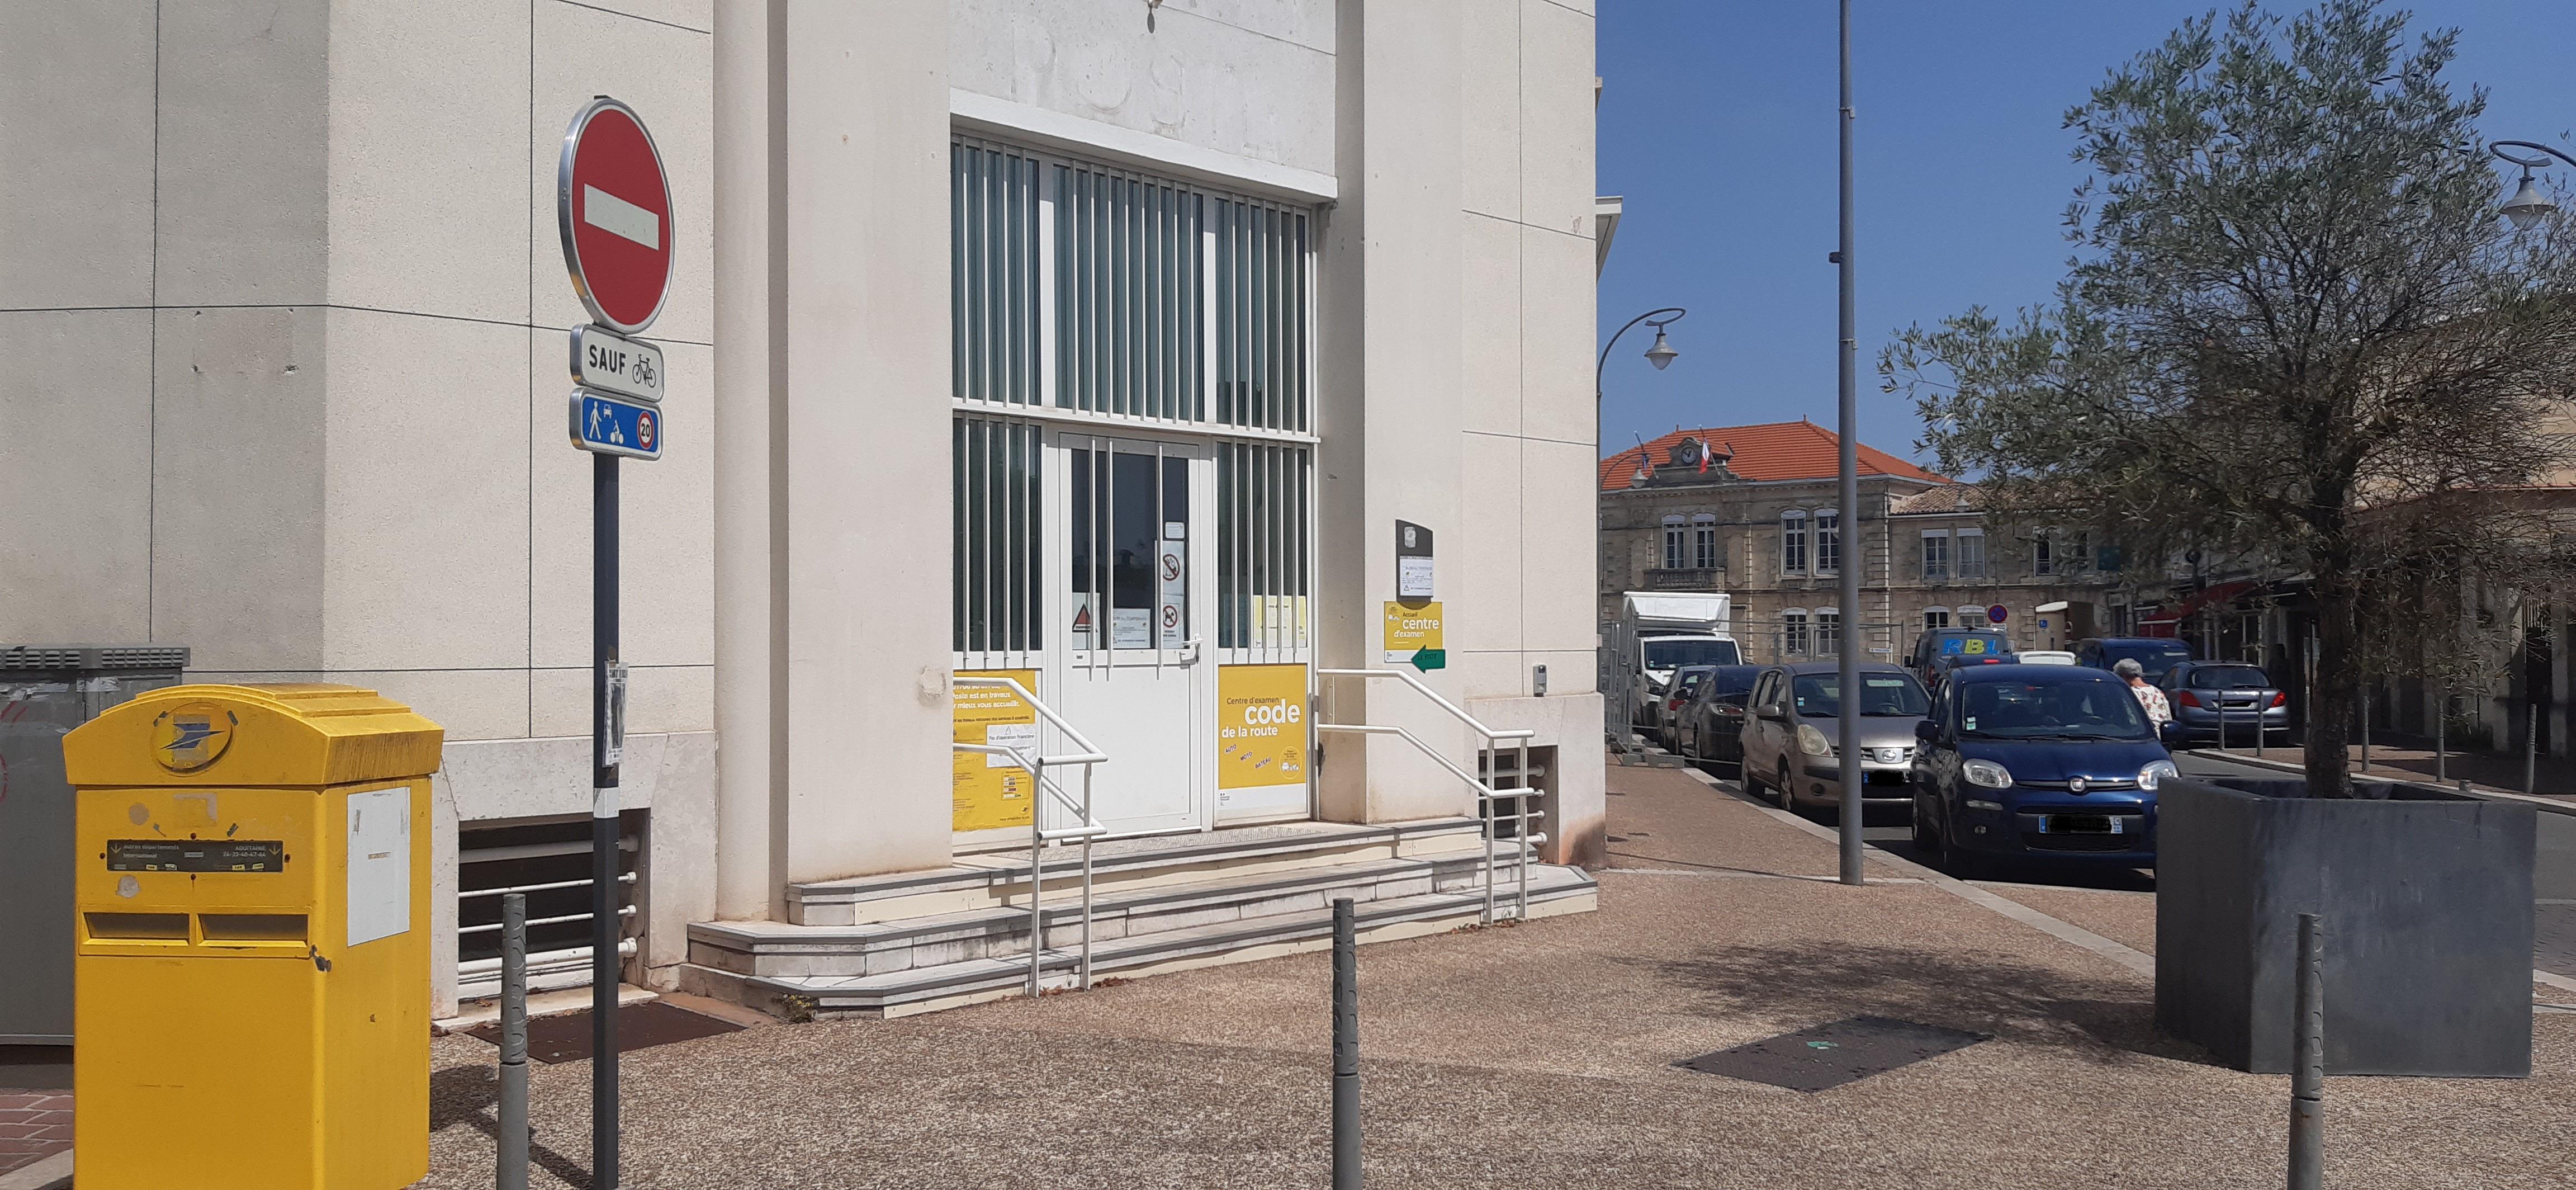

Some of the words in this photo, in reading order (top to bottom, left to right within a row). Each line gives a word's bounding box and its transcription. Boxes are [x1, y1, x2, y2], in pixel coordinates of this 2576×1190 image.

[589, 344, 626, 375] SAUF
[641, 424, 650, 437] 20
[1402, 617, 1439, 630] centre
[1942, 639, 2000, 655] RBL
[1244, 698, 1300, 725] code
[1221, 726, 1235, 738] de
[1238, 725, 1248, 737] la
[1250, 725, 1278, 736] route
[1225, 744, 1237, 753] AUTO
[1240, 751, 1252, 761] MOTO
[1255, 757, 1271, 769] BATEAU
